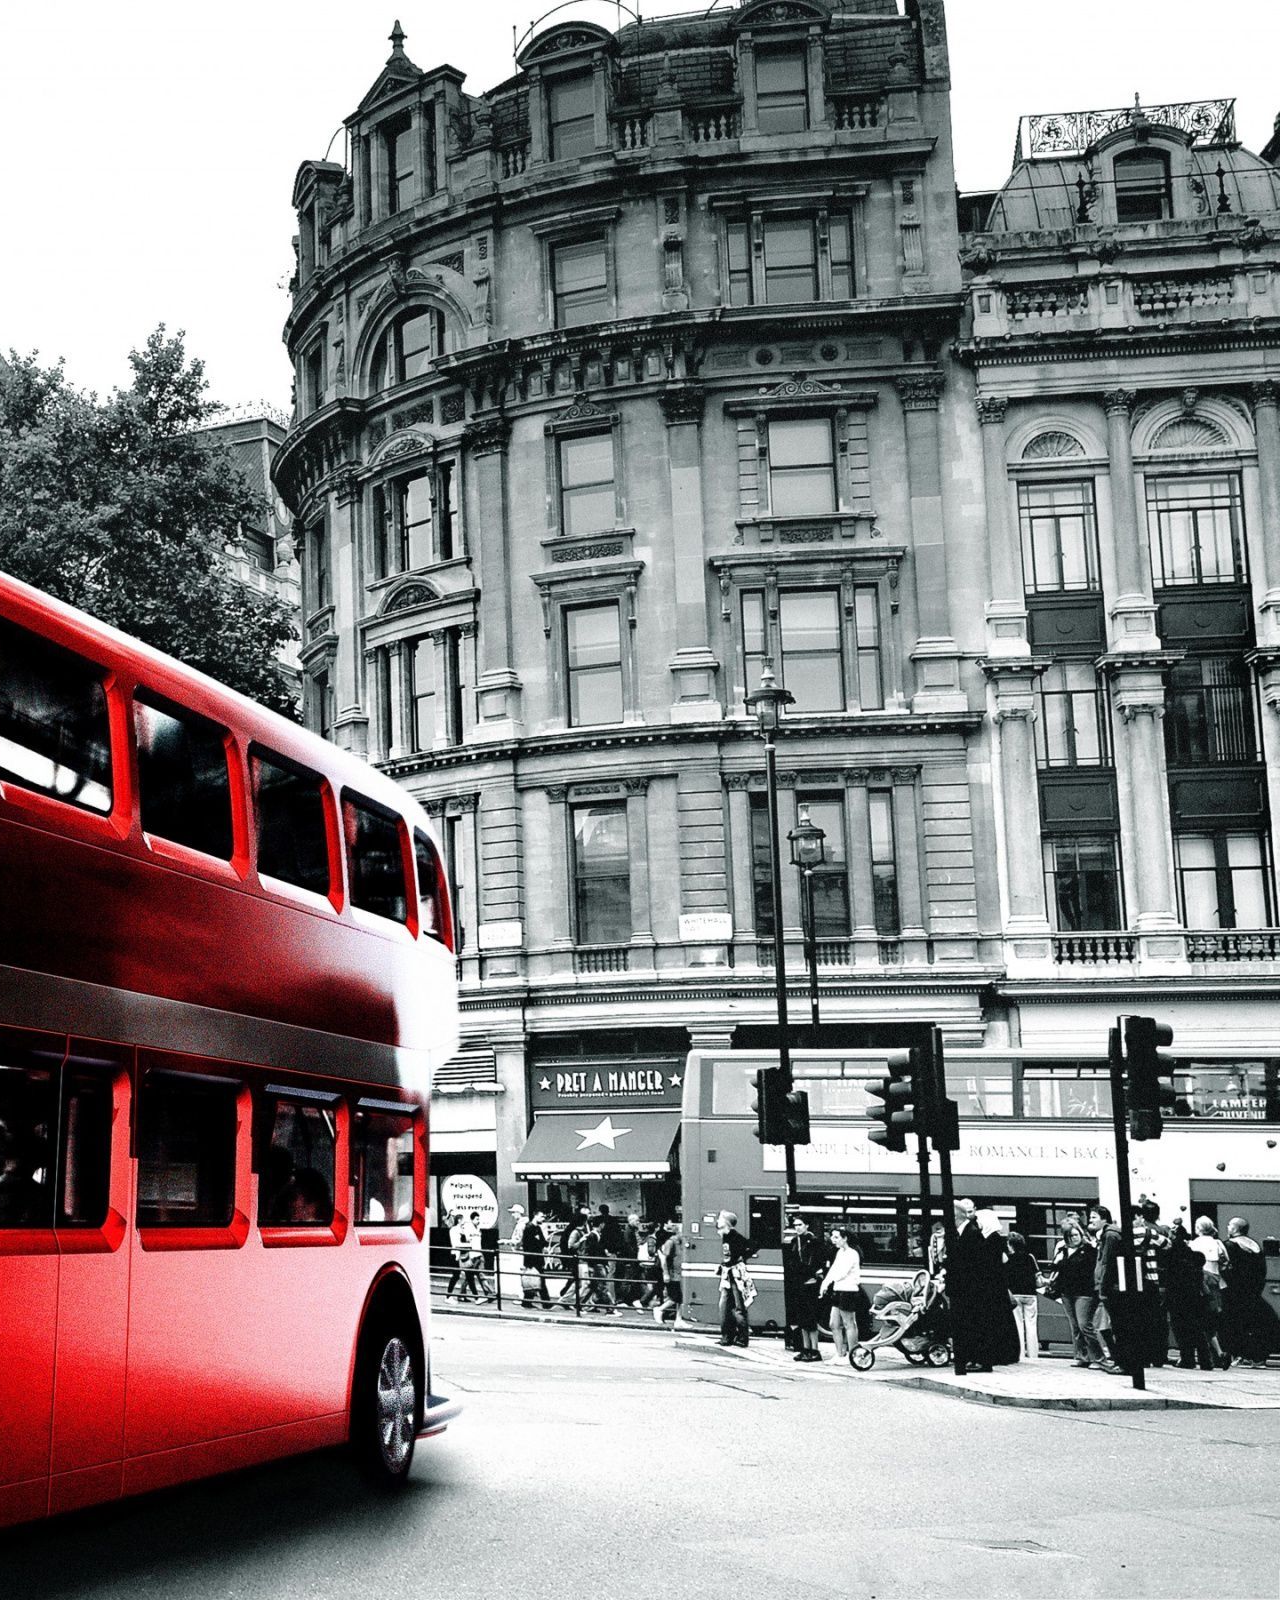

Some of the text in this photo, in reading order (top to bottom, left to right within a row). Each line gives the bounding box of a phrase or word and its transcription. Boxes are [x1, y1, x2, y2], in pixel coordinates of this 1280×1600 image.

[556, 1070, 664, 1093] PRET A MANGER
[969, 1145, 1049, 1159] ROMANCE
[1073, 1146, 1115, 1160] BACK
[450, 1182, 473, 1190] Helping
[468, 1204, 495, 1212] everyday
